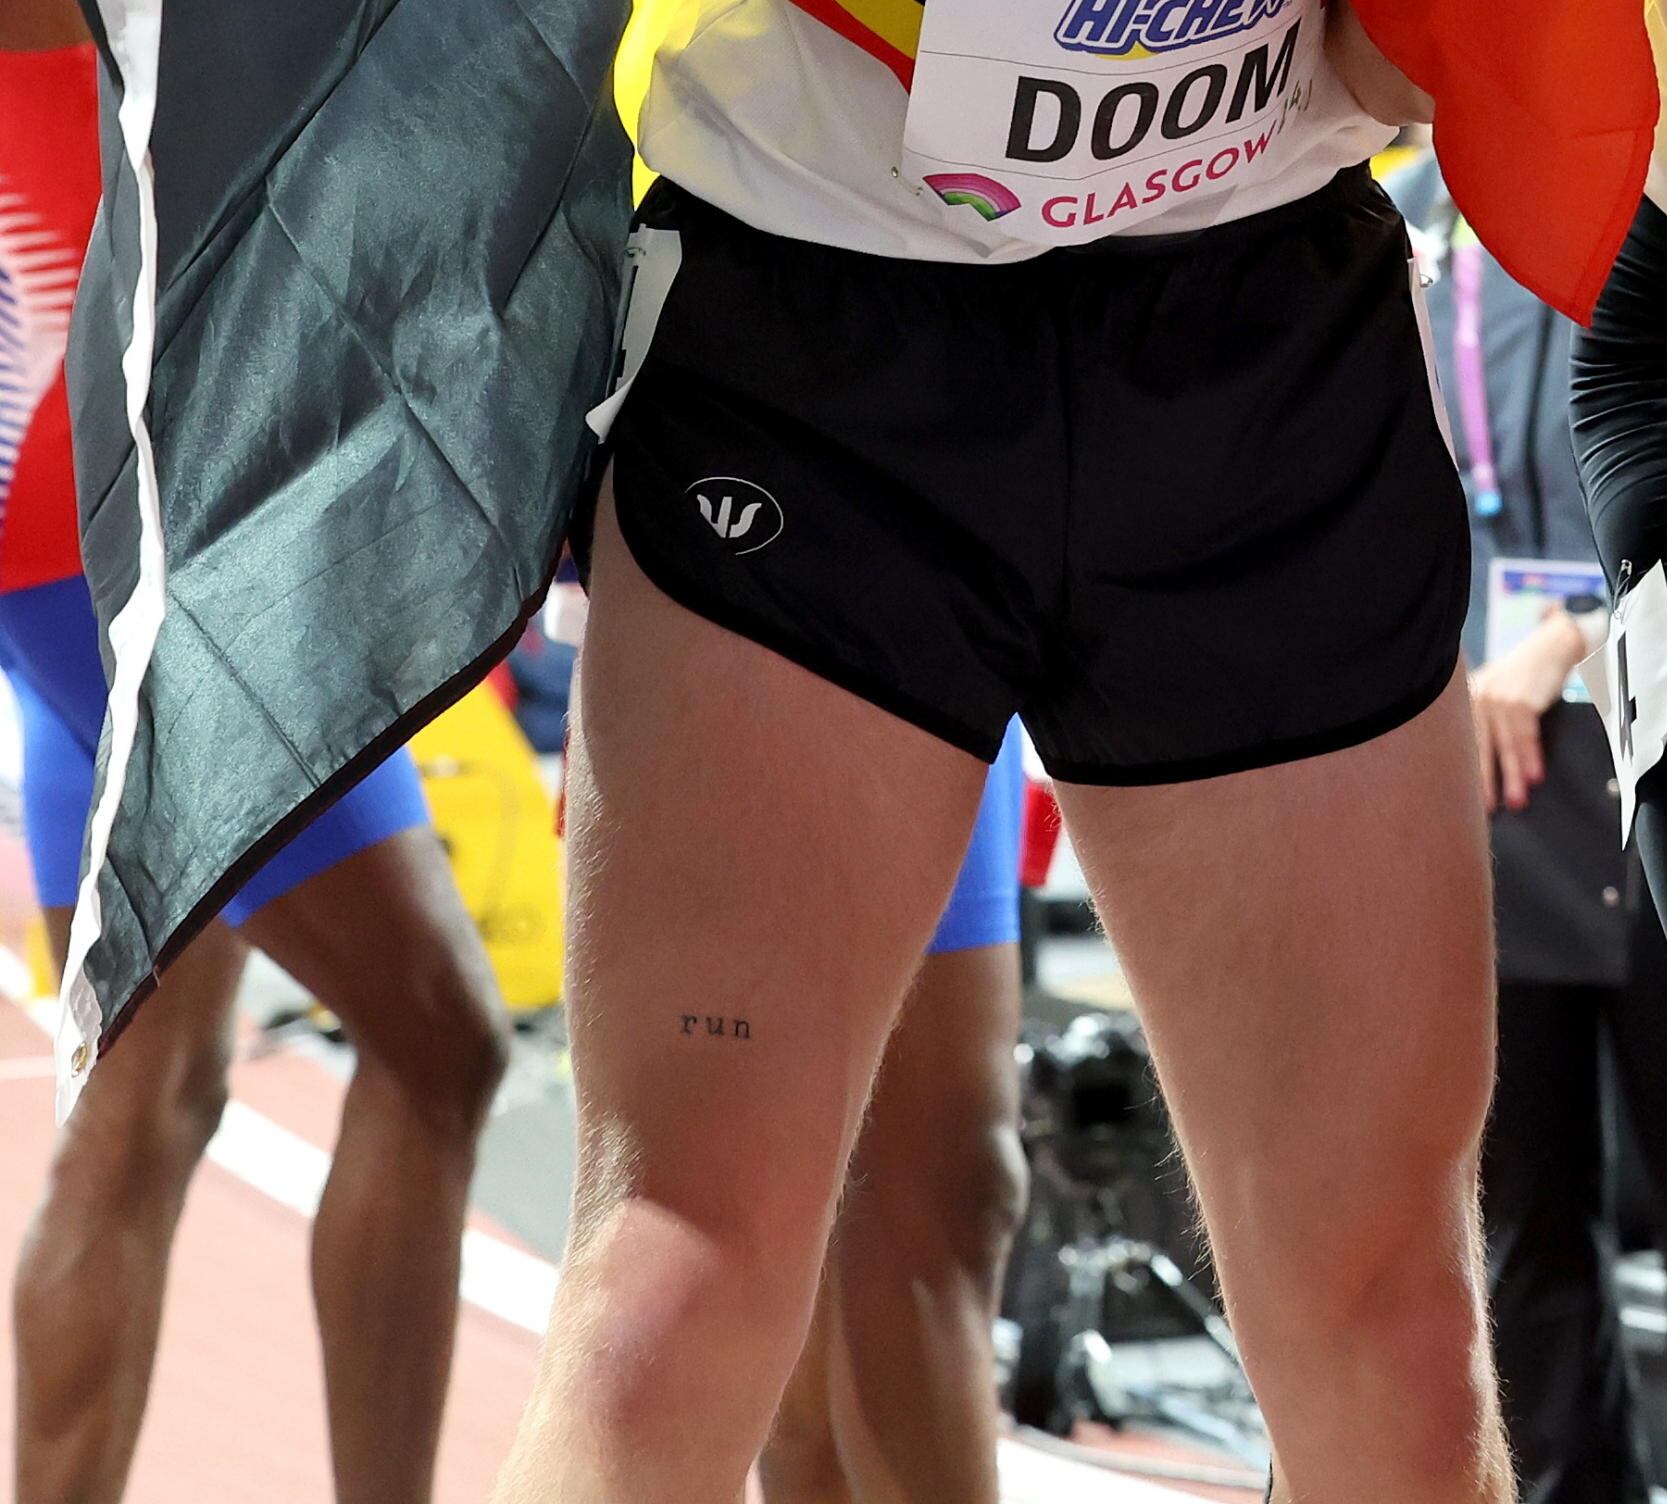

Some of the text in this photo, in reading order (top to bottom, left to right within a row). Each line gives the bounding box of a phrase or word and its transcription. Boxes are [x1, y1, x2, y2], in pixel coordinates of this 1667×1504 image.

[1005, 17, 1302, 164] DOOM
[1041, 119, 1277, 229] GLASGOW
[680, 1013, 752, 1039] run
